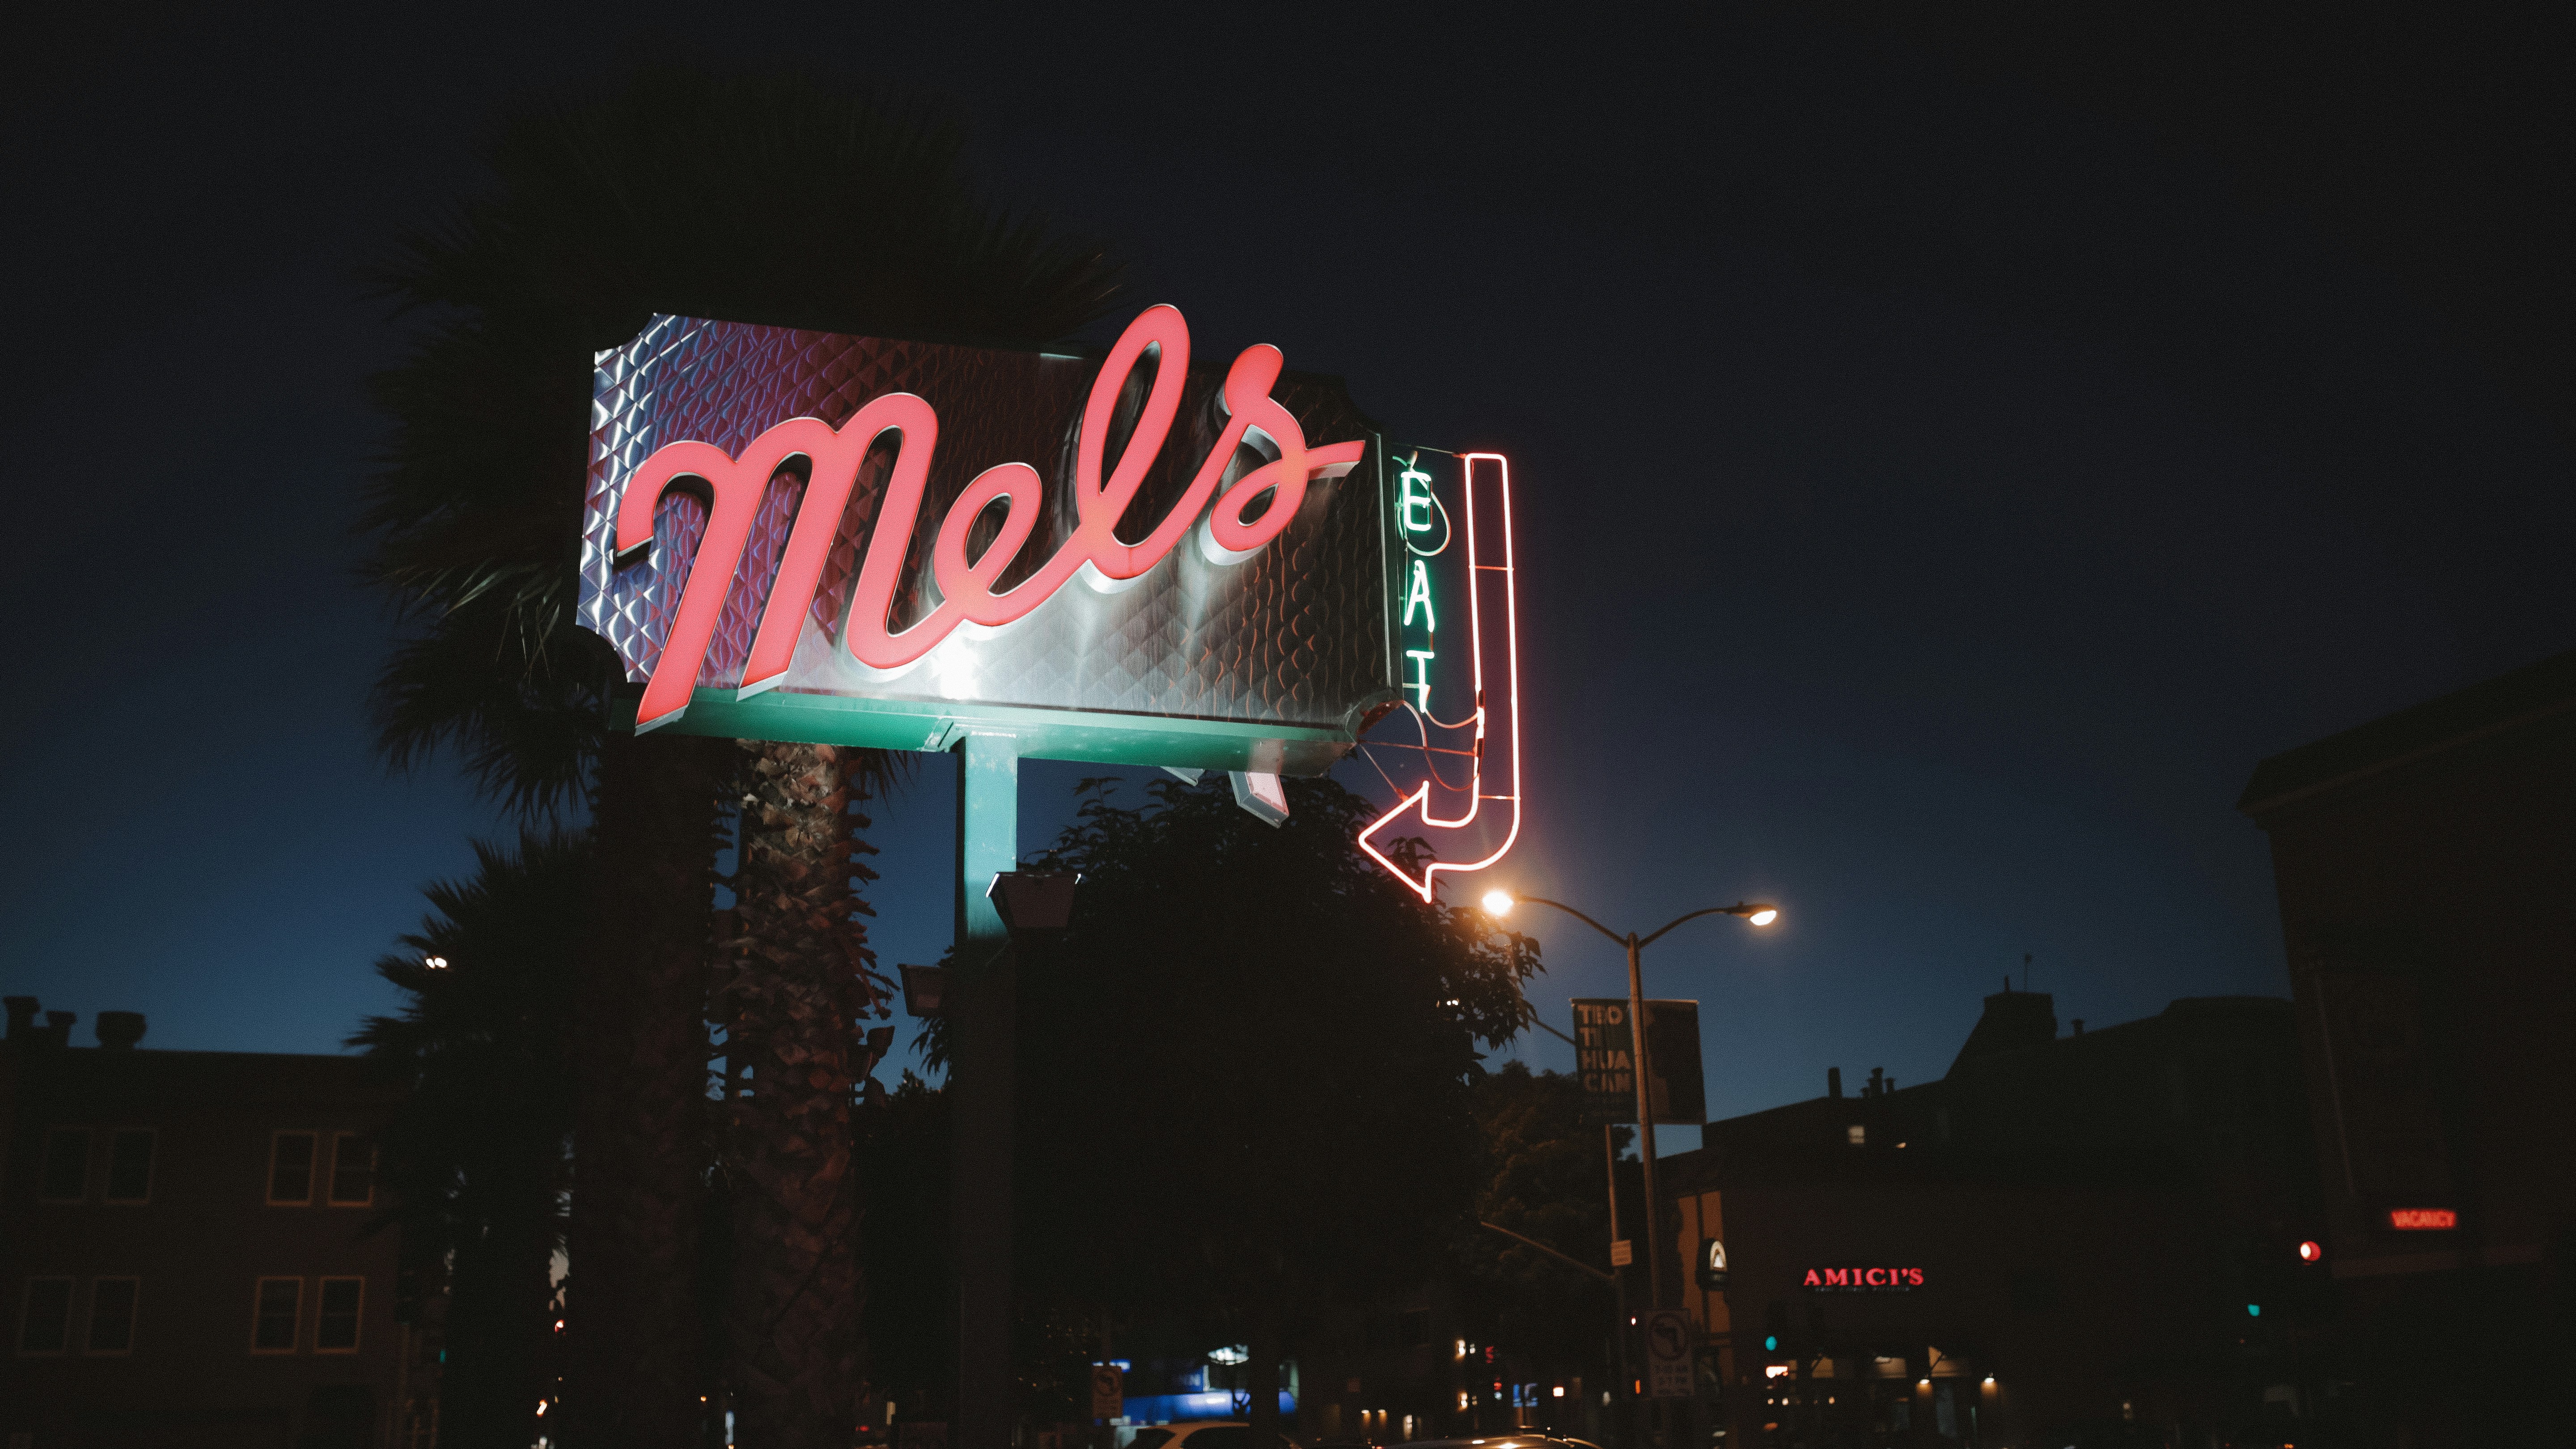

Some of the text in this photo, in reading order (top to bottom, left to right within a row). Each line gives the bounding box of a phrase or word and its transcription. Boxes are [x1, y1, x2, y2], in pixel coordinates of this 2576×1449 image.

[615, 302, 1366, 736] Mels
[1400, 471, 1435, 713] EAT
[1577, 1004, 1623, 1025] TEO
[1581, 1050, 1631, 1070] HUA
[2392, 1211, 2454, 1227] VACANCY
[1803, 1267, 1924, 1286] AMICI'S
